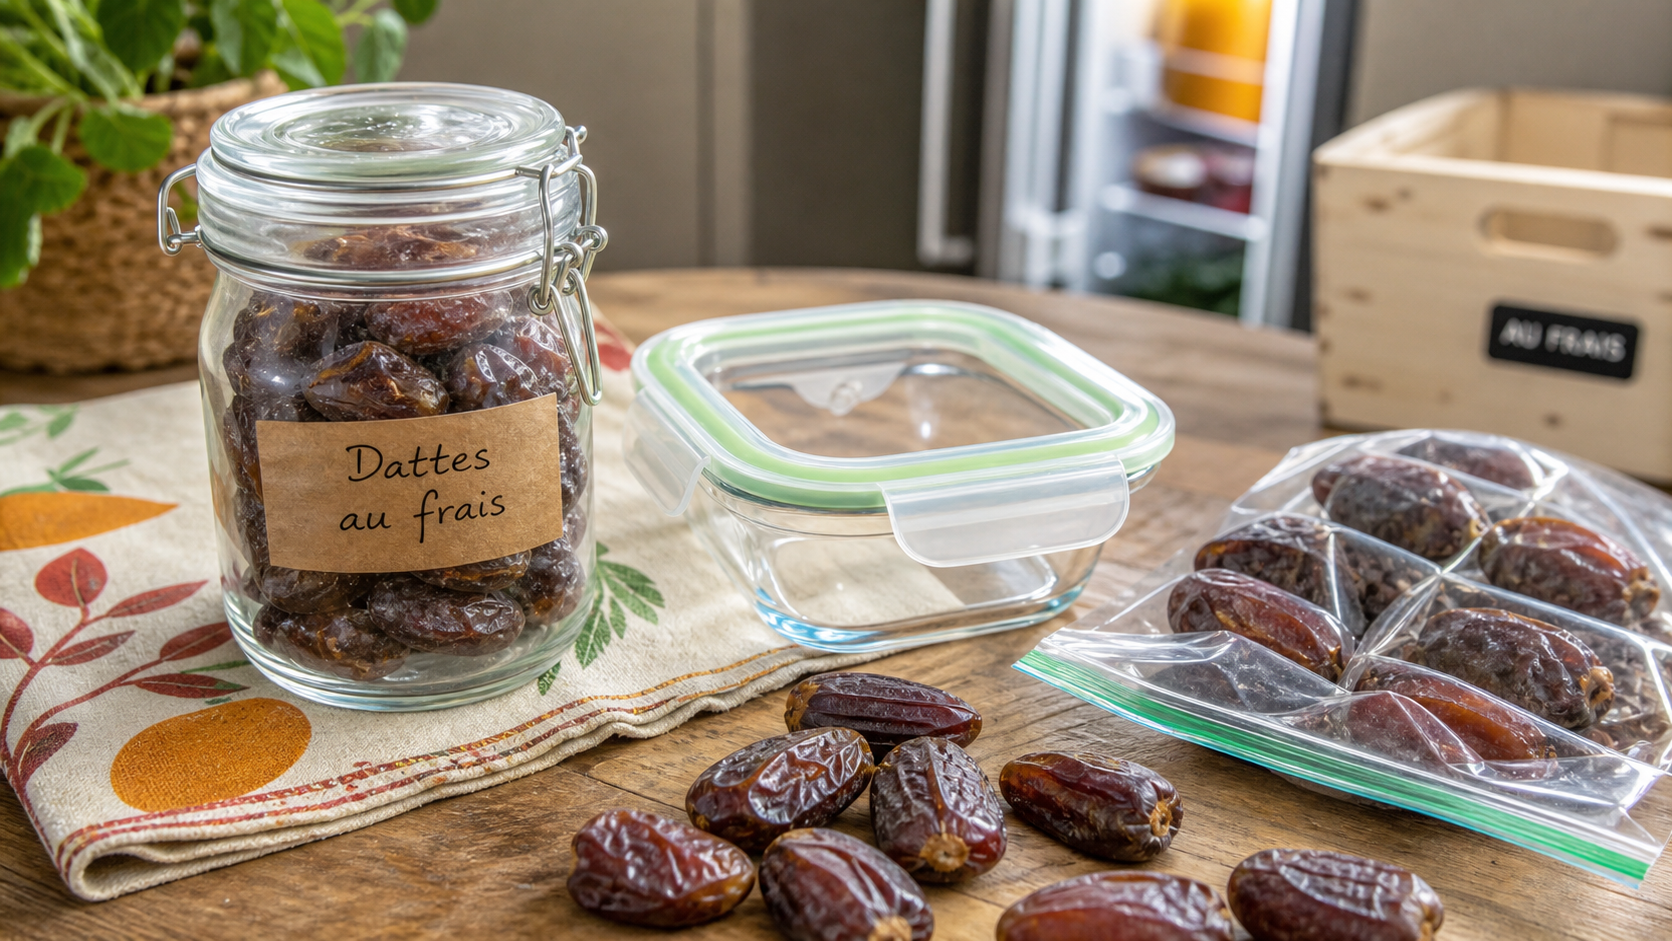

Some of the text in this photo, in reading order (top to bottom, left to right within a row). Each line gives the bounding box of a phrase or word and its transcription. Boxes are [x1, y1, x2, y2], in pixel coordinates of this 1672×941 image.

[1499, 317, 1627, 363] AU FRAIS
[345, 443, 490, 482] Dattes
[339, 489, 506, 544] au frais
